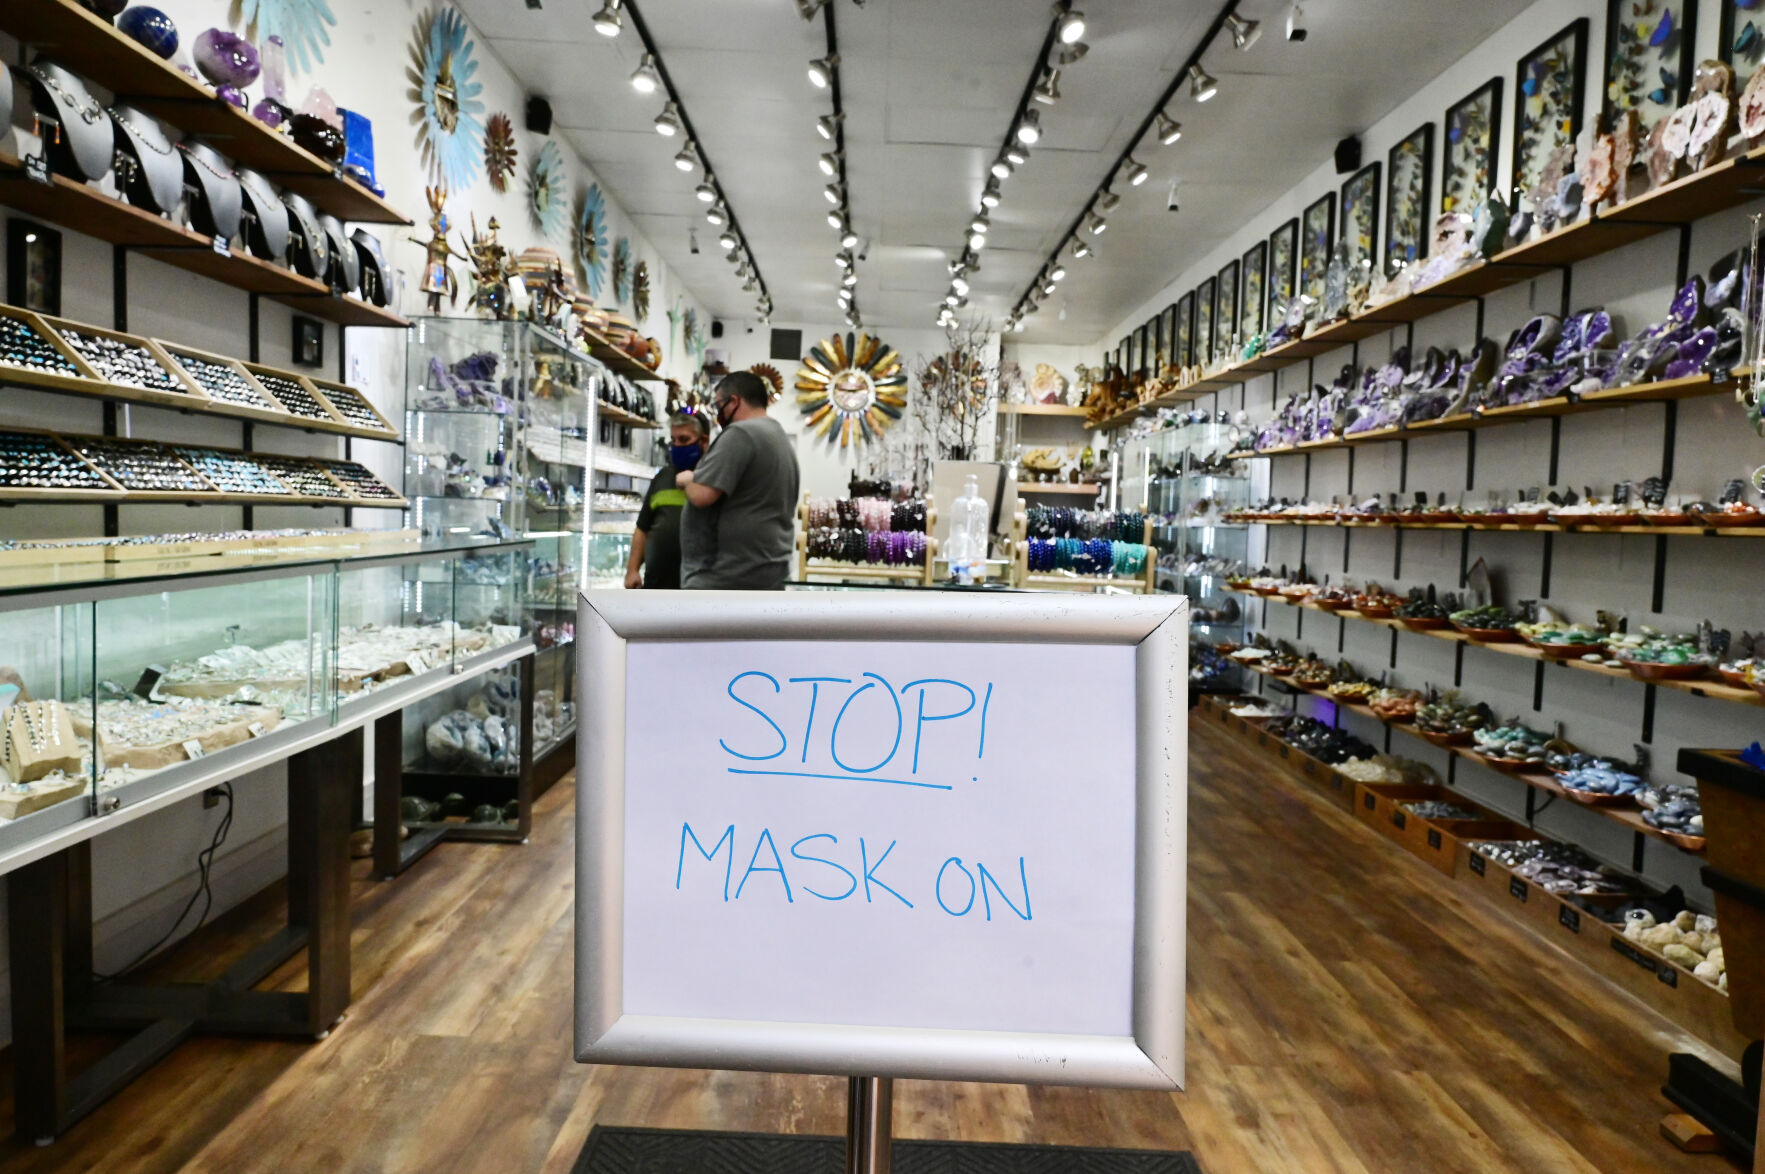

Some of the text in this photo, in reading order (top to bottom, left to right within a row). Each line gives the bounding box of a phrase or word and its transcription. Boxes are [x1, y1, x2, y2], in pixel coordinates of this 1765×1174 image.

[720, 670, 994, 782] STOP!
[676, 822, 1032, 922] MASK ON
